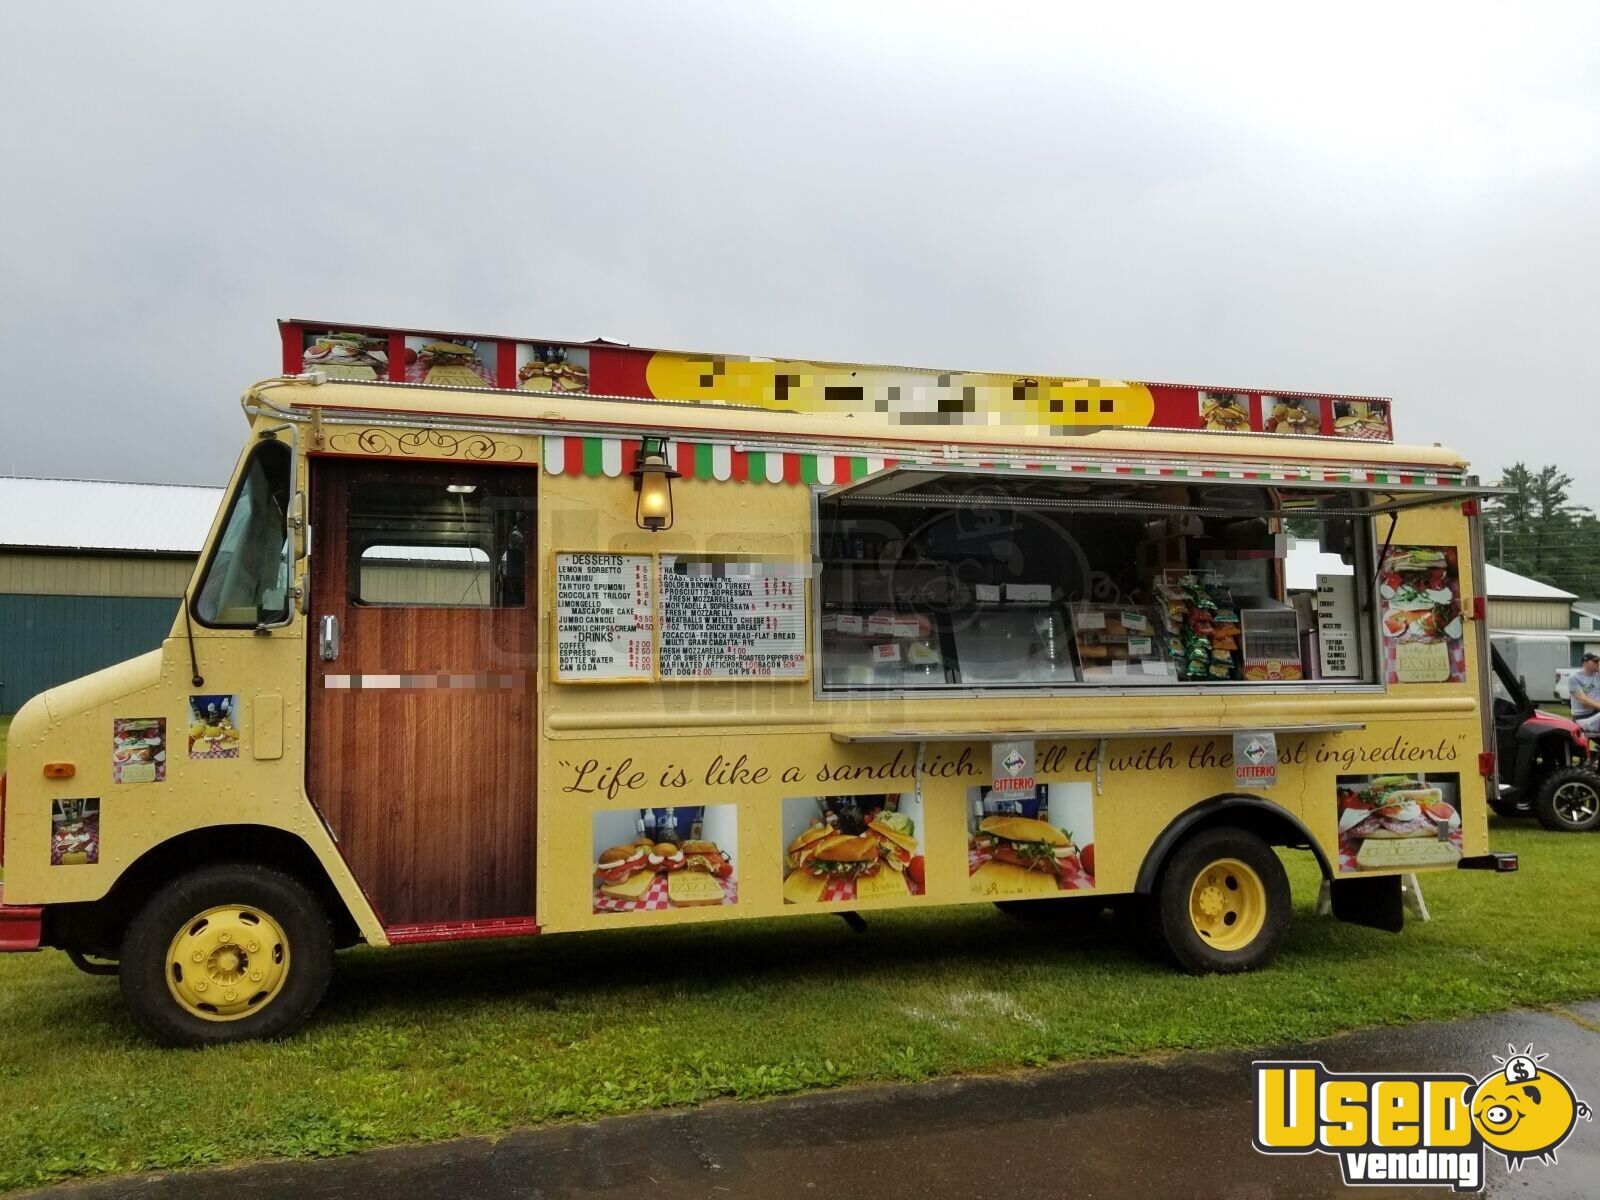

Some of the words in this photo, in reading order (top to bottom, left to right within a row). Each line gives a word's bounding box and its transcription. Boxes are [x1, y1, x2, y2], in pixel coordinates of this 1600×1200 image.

[572, 554, 623, 566] DESSERTS
[578, 632, 614, 642] DRINKS
[659, 764, 692, 788] is
[704, 754, 771, 786] like
[781, 766, 806, 783] a
[1034, 744, 1067, 774] ill
[1074, 747, 1100, 772] it
[1109, 742, 1179, 771] with
[1188, 740, 1233, 769] the
[1236, 765, 1276, 778] CITTERIO
[993, 777, 1035, 792] CITTERIO
